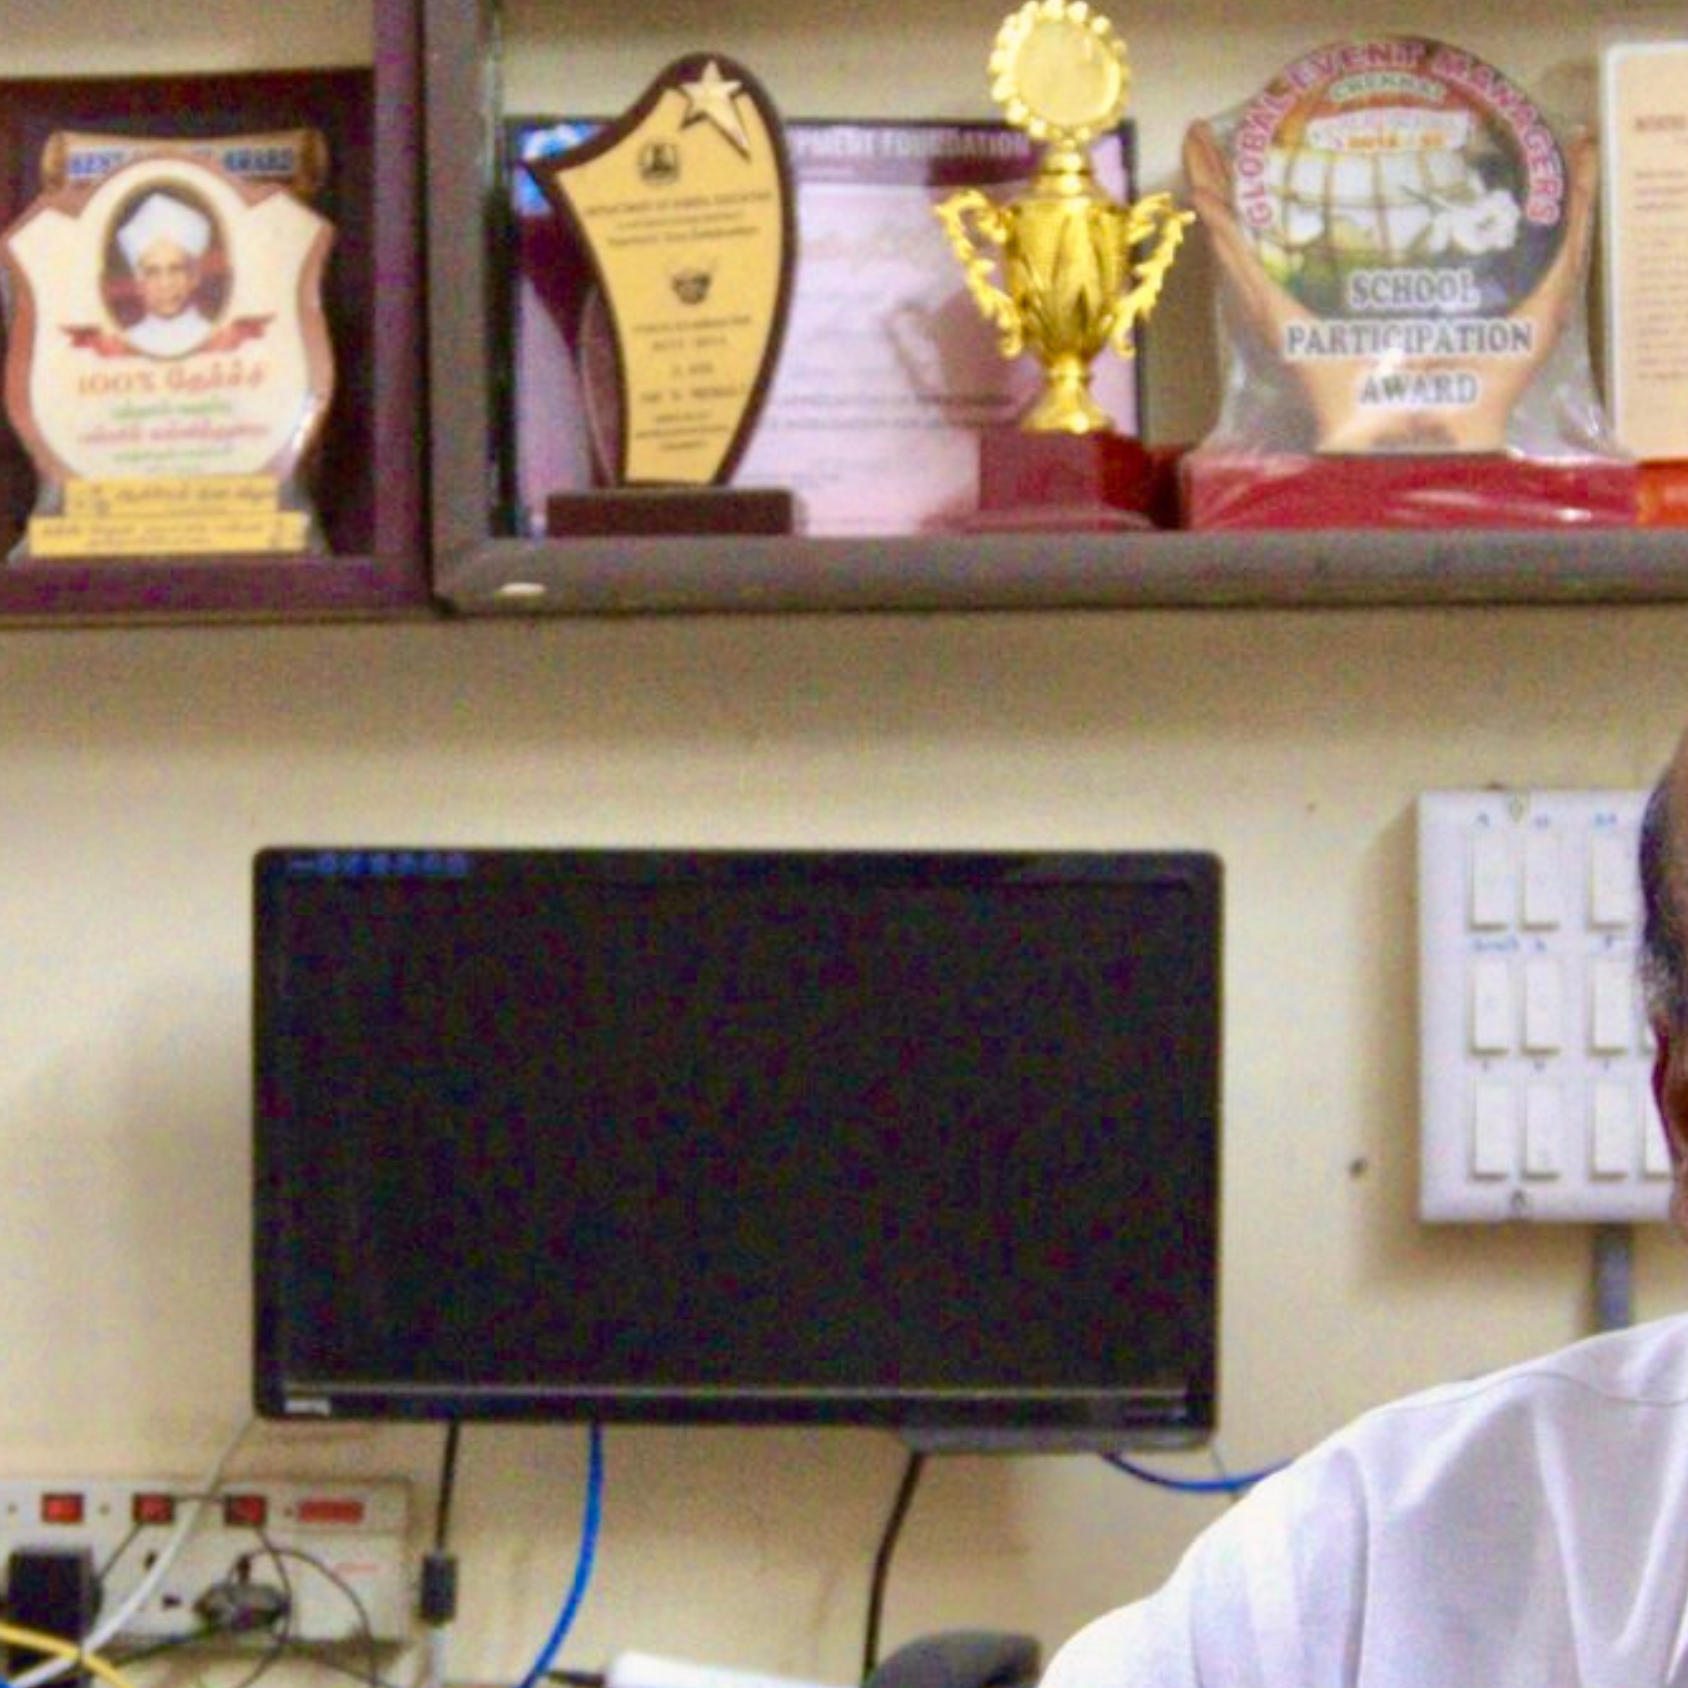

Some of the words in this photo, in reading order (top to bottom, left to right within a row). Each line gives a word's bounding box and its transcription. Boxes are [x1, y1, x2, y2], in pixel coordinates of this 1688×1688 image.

[1236, 88, 1294, 229] GLOBAL
[1286, 41, 1426, 90] EVENT
[1432, 46, 1563, 226] MANAGERS
[1350, 272, 1477, 309] SCHOOL
[1286, 322, 1534, 357] PARTICIPATION
[1360, 373, 1479, 406] AWARD
